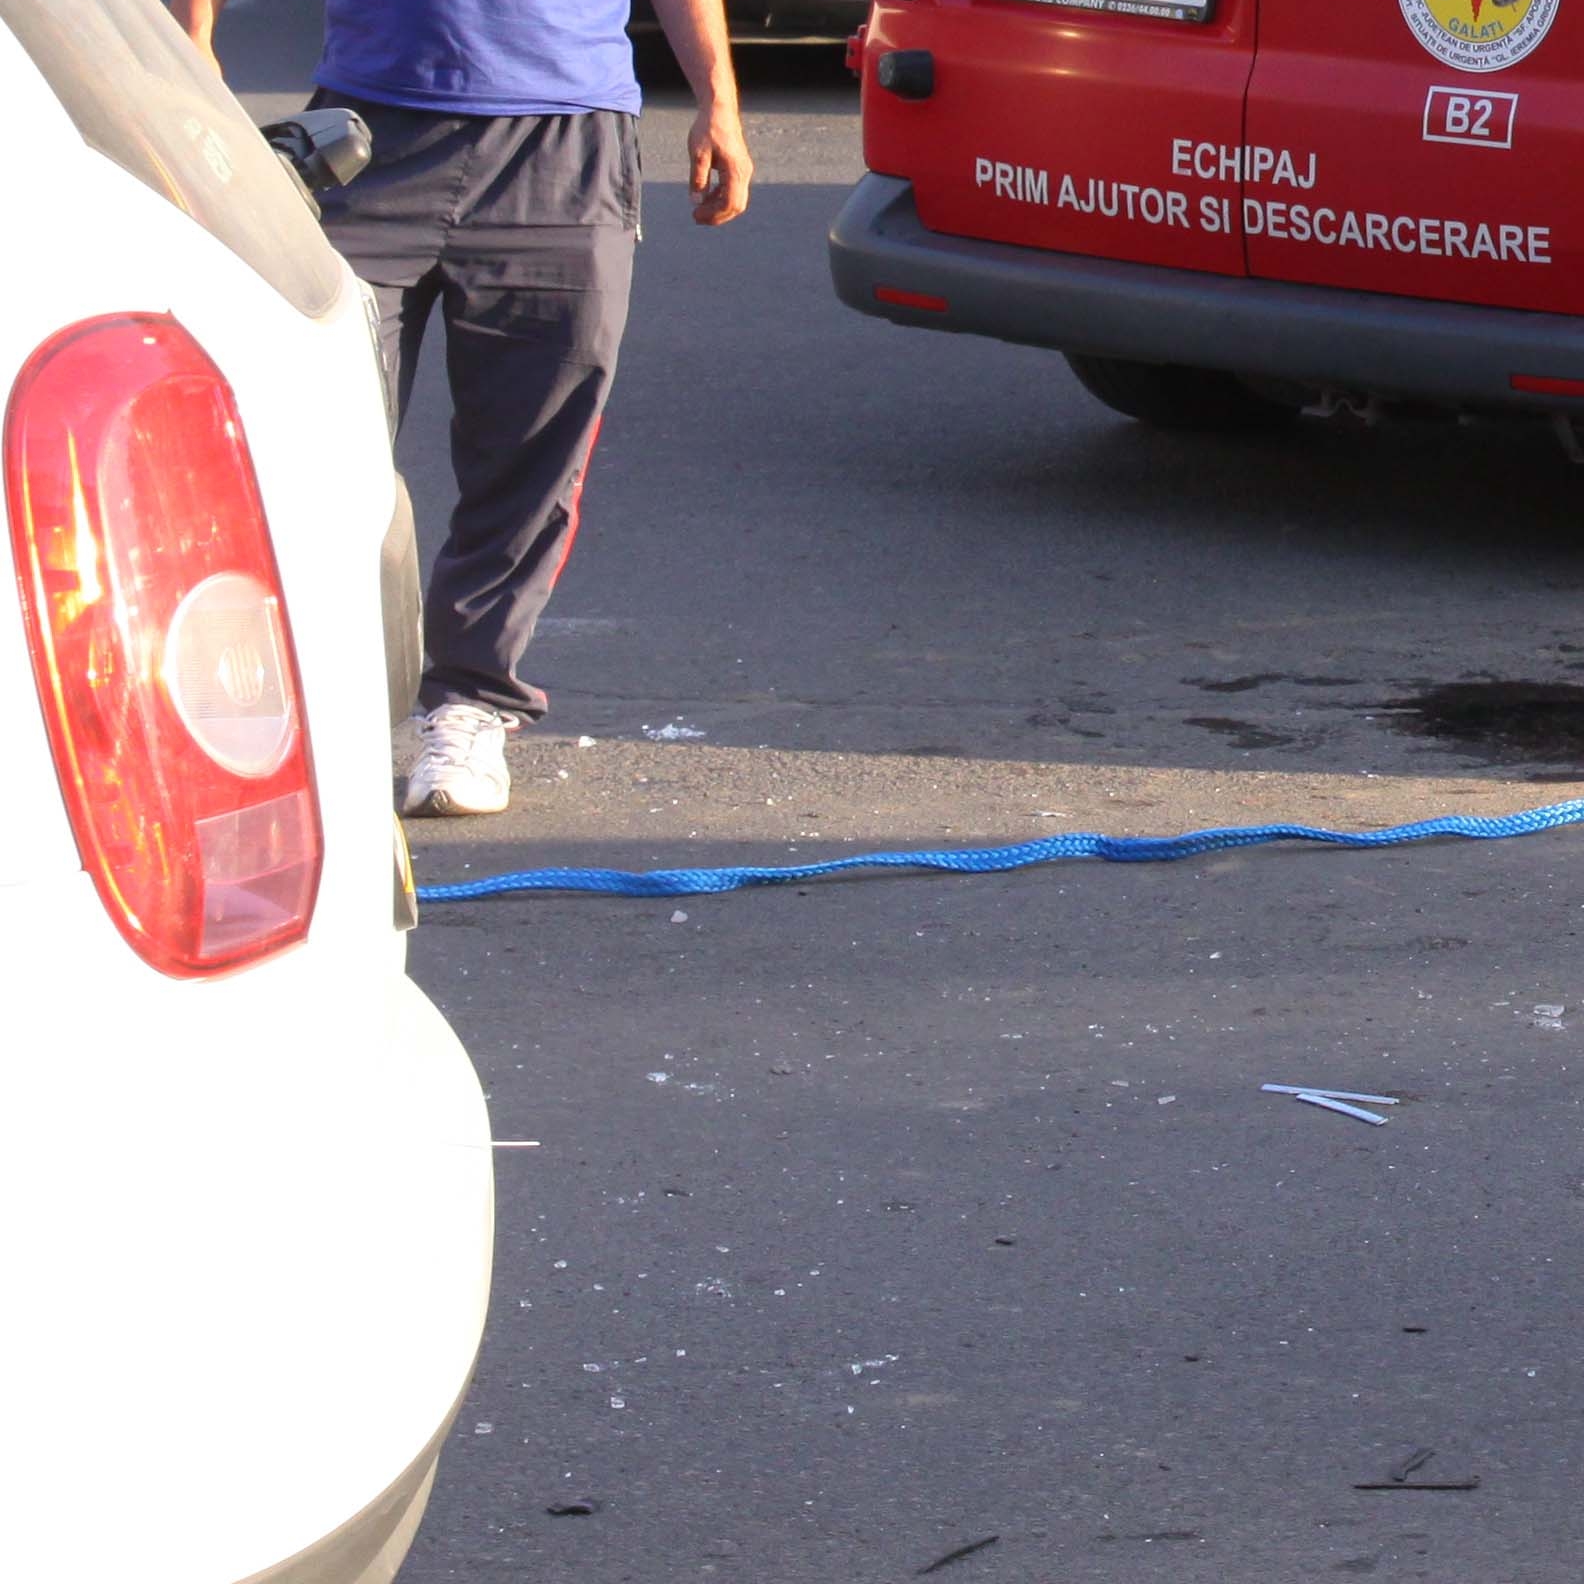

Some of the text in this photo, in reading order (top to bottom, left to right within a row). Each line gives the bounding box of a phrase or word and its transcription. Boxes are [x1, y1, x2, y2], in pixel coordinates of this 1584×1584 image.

[1436, 43, 1448, 56] DE
[1459, 43, 1472, 52] DE
[1445, 96, 1495, 139] B2
[1171, 138, 1317, 189] ECHIPAJ
[975, 157, 1552, 264] PRIM AJUTOR SI DESCARCERARE
